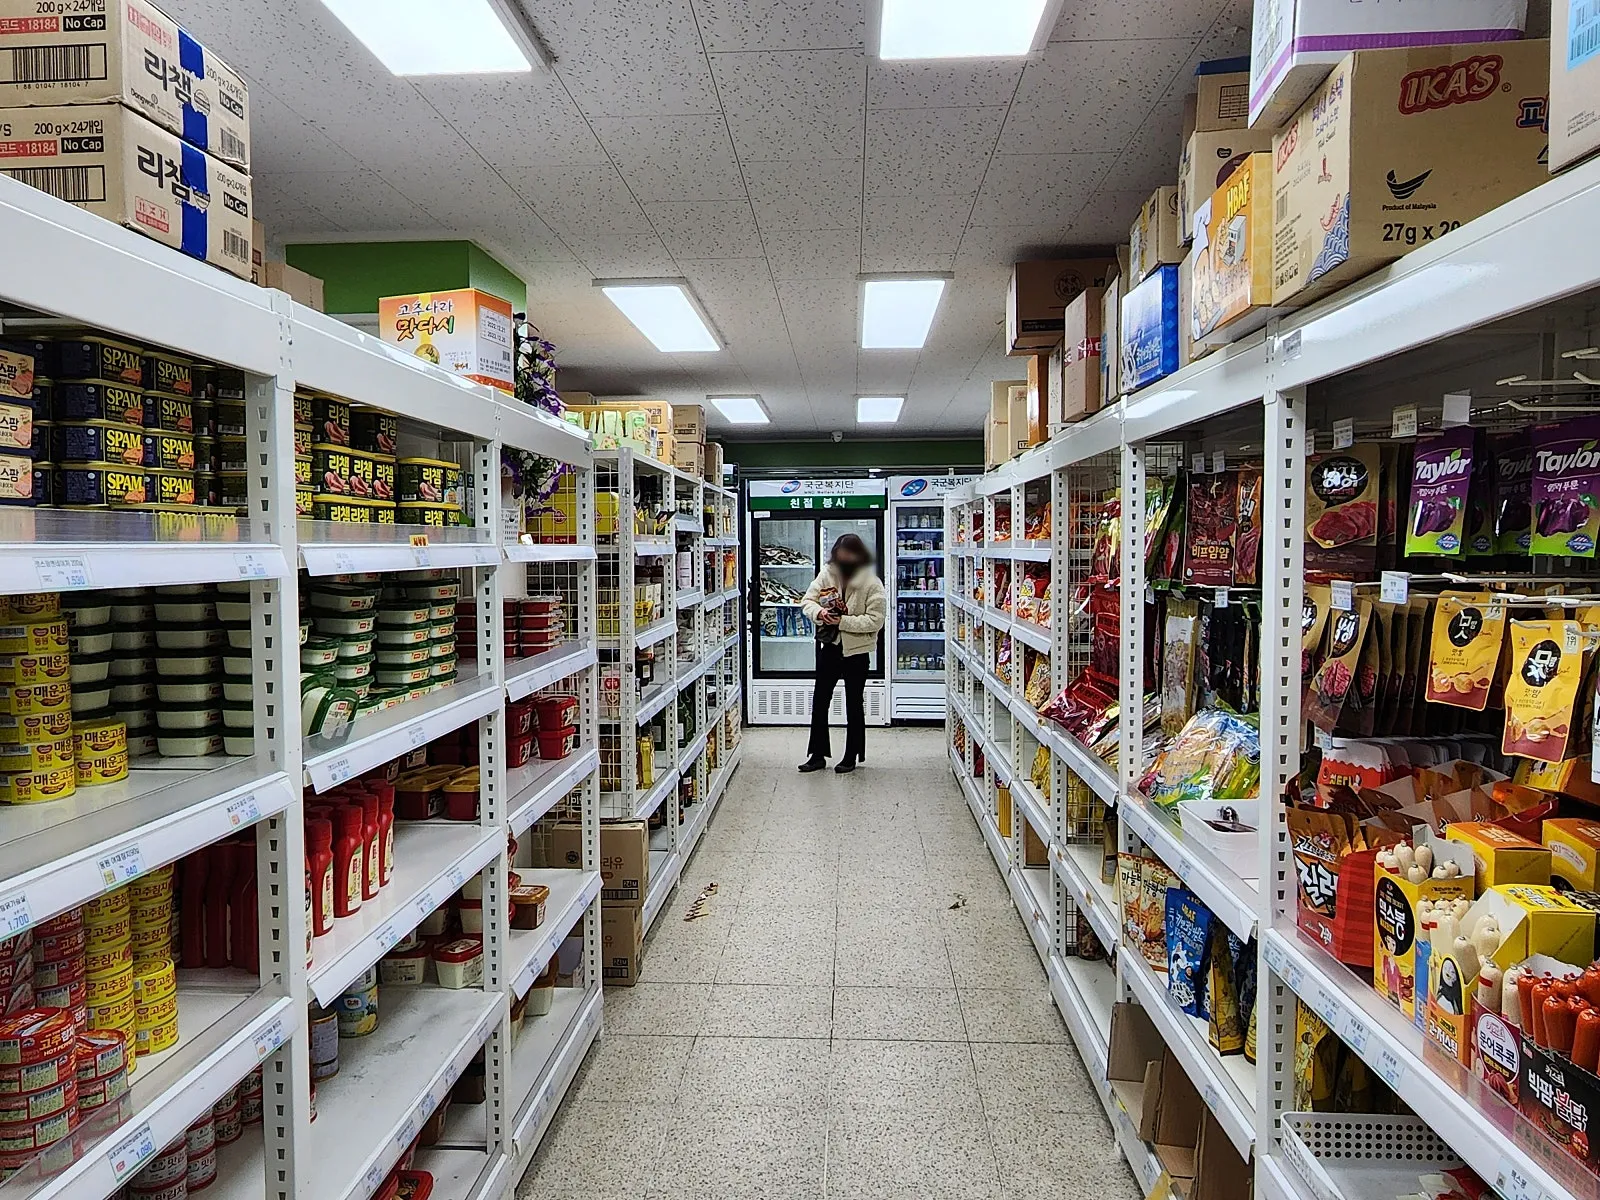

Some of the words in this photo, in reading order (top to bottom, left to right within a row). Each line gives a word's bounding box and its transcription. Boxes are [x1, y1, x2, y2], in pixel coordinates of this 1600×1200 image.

[28, 19, 57, 30] 18184
[65, 18, 81, 29] No
[83, 17, 103, 29] Cap
[144, 47, 192, 103] 리챔
[1404, 57, 1501, 110] IKA'S
[220, 91, 230, 107] No
[230, 100, 243, 118] Cap
[35, 123, 53, 134] 200
[26, 143, 55, 153] 18184
[64, 140, 78, 150] No
[81, 139, 102, 151] Cap
[1227, 170, 1250, 220] HBAF
[224, 193, 234, 207] No
[234, 200, 247, 216] Cap
[1412, 202, 1436, 211] Malaysia
[1383, 223, 1417, 245] 27g
[1422, 226, 1434, 240] x
[398, 301, 453, 316] 고추나라
[396, 315, 455, 342] 맛다시
[103, 347, 140, 371] SPAM
[158, 362, 189, 382] SPAM
[106, 388, 142, 409] SPAM
[162, 400, 192, 418] SPAM
[328, 404, 349, 426] 리챔
[106, 430, 141, 449] SPAM
[162, 438, 193, 455] SPAM
[328, 455, 350, 479] 리챔
[354, 460, 373, 482] 리챔
[1416, 458, 1470, 483] Taylor
[1536, 449, 1600, 475] Taylor
[107, 473, 143, 491] SPAM
[376, 465, 394, 483] 리챔
[422, 468, 444, 485] 리챔
[161, 477, 192, 493] SPAM
[804, 480, 854, 489] 국군복지단
[790, 498, 813, 508] 친절
[823, 498, 847, 508] 봉사
[424, 510, 444, 526] 리챔
[1191, 545, 1230, 559] 비프얌얌
[1294, 857, 1339, 906] 질러
[8, 914, 29, 931] 1,700
[43, 1048, 55, 1057] HOT
[1479, 1030, 1517, 1069] 문어콕콕
